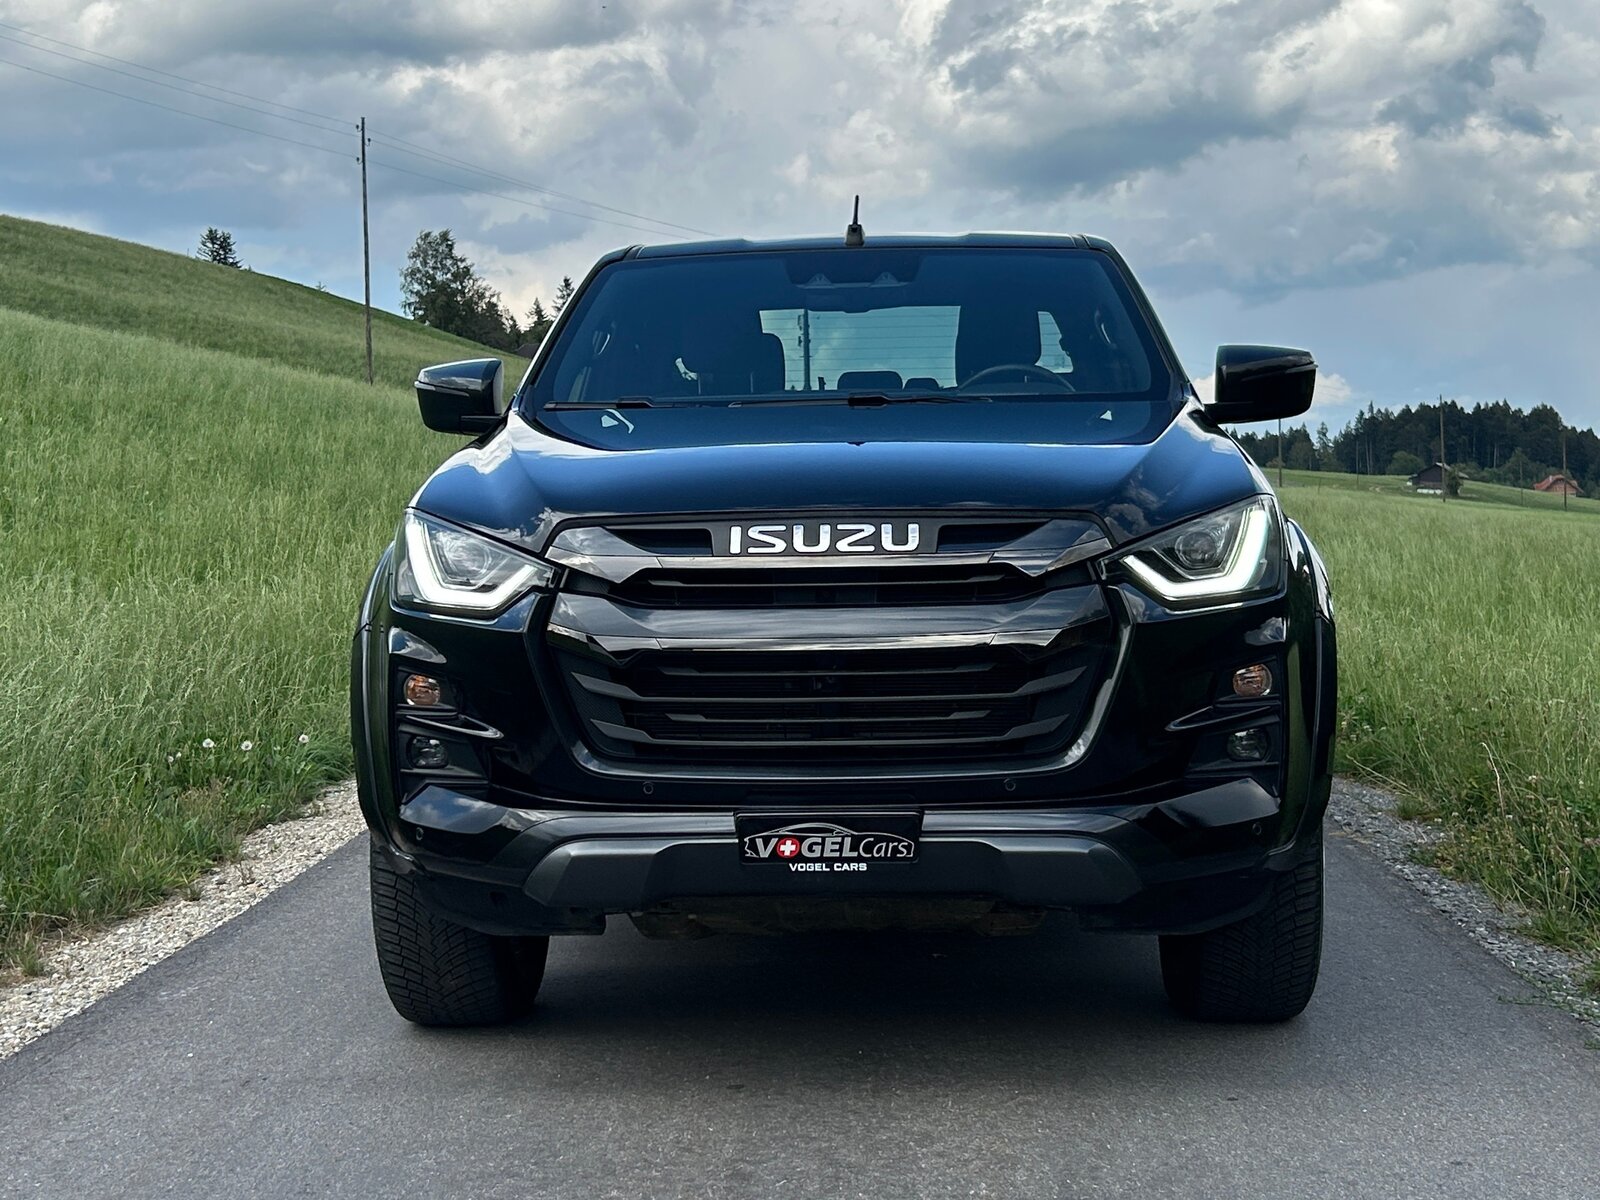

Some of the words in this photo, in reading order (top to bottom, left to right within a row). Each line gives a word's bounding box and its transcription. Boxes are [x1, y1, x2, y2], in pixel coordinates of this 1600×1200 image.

[730, 523, 919, 554] ISUZU
[789, 862, 830, 871] VOGEL
[833, 862, 868, 871] CARS
